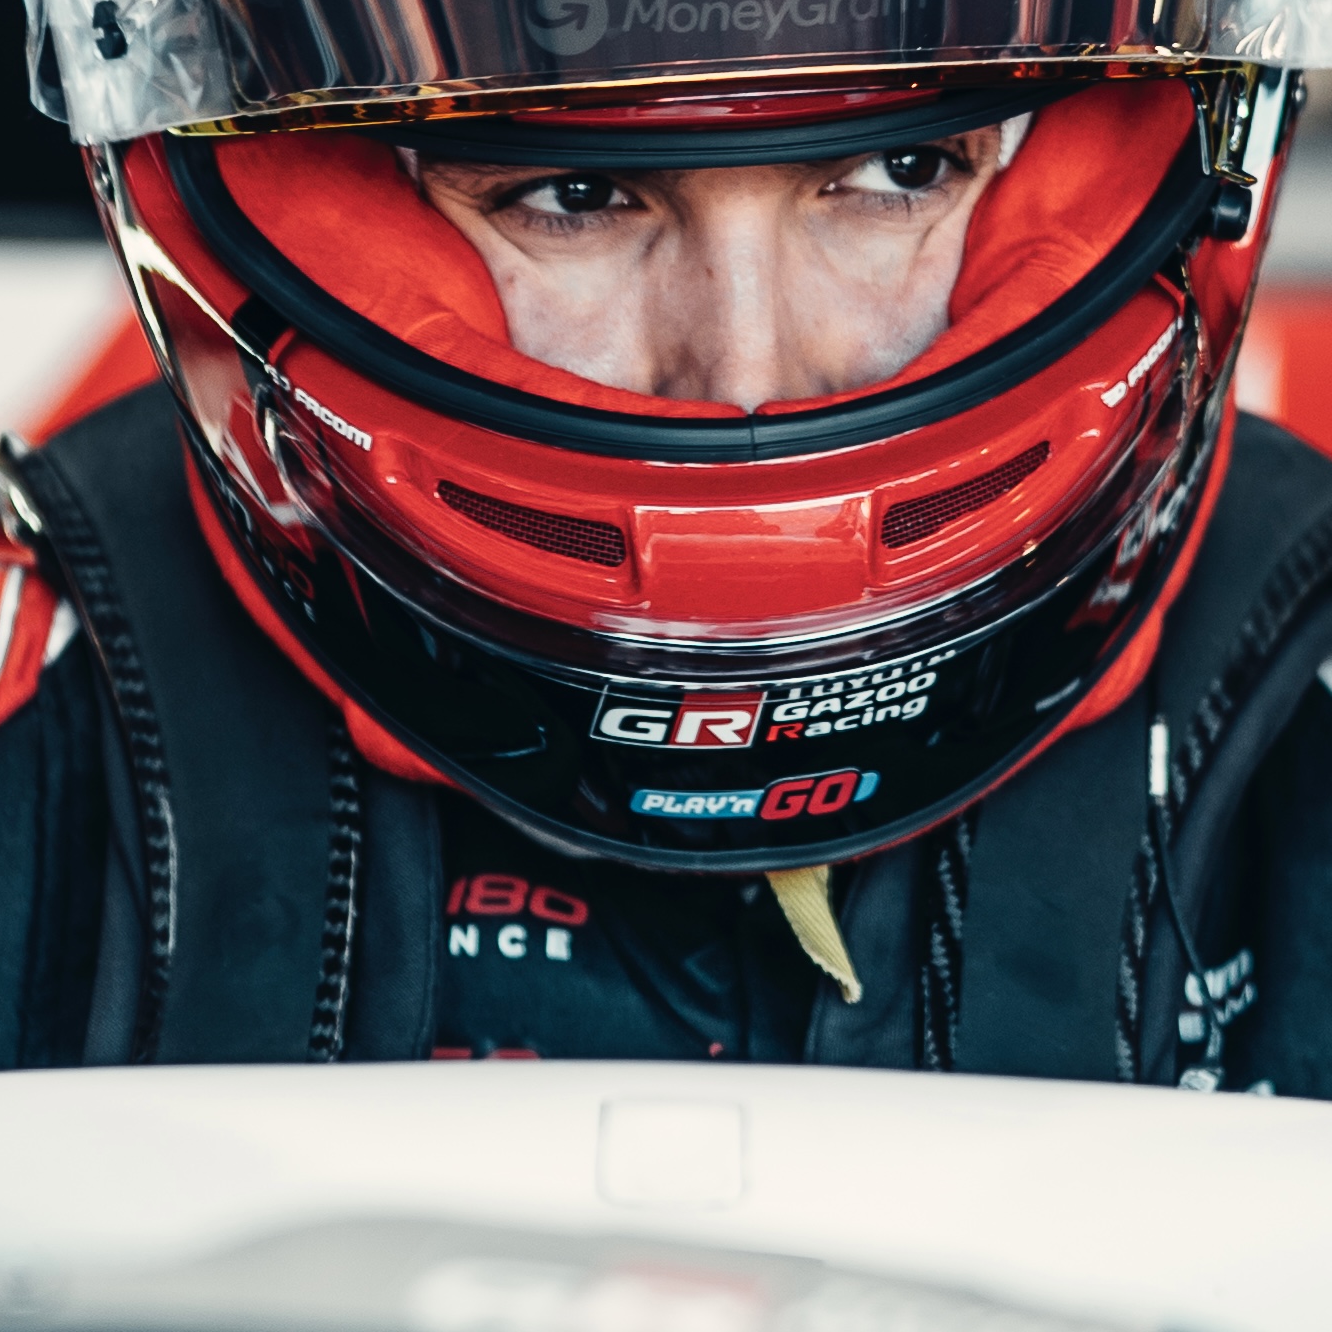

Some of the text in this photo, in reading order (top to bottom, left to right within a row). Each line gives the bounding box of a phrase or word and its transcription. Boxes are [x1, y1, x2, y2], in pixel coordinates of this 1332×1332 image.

[766, 695, 929, 742] Racing
[772, 671, 938, 722] GAZOO
[599, 707, 752, 744] GR
[760, 770, 859, 820] GO
